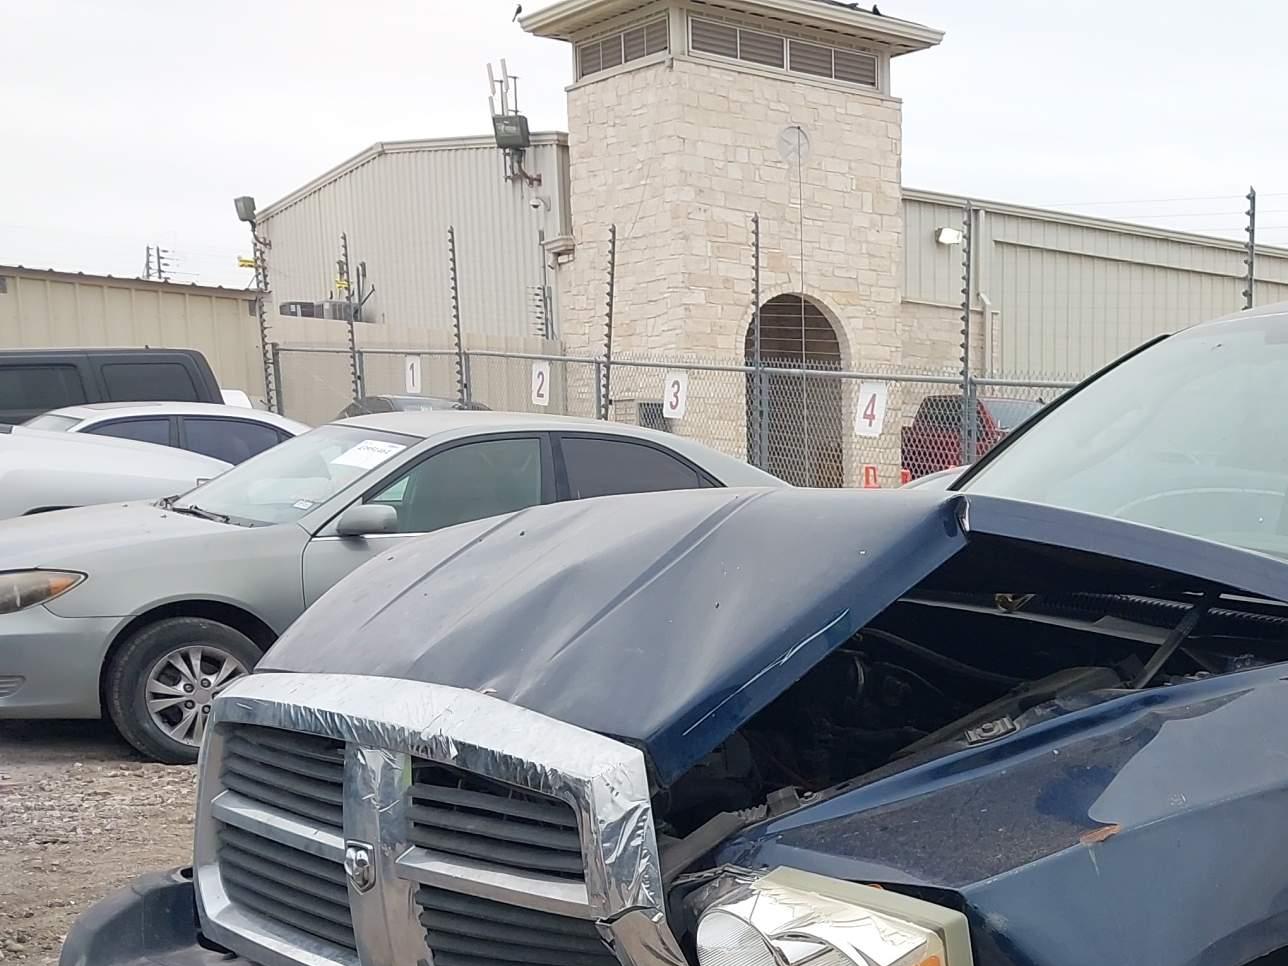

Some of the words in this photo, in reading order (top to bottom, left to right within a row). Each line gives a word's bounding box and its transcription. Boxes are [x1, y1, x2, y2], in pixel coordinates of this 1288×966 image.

[409, 362, 415, 388] 1
[536, 371, 545, 398] 2
[669, 380, 681, 410] 3
[863, 393, 877, 427] 4
